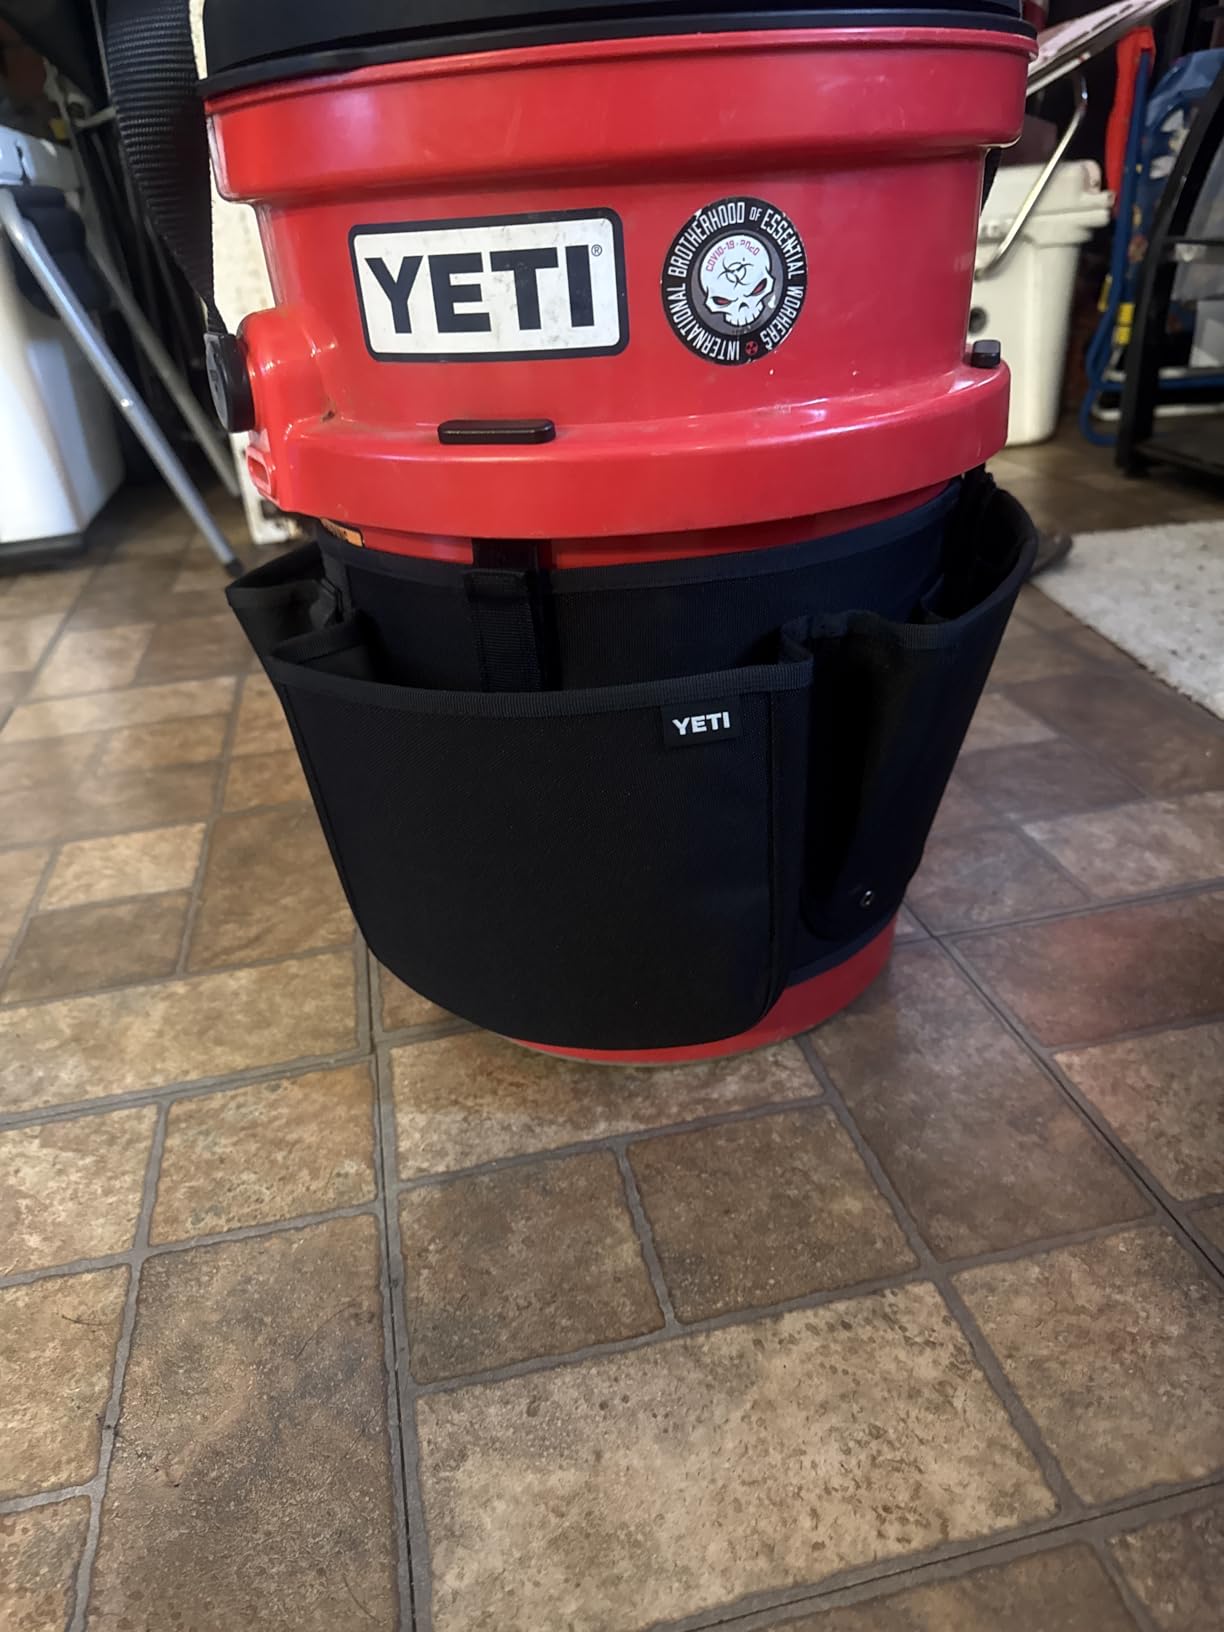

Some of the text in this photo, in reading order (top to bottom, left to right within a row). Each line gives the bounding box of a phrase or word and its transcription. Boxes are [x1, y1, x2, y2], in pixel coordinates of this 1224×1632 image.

[667, 202, 745, 278] BROTHERHOOD
[749, 206, 762, 221] OF
[760, 209, 805, 279] ESSENTIAL
[667, 283, 740, 361] INTERNATIONAL
[672, 711, 730, 735] YETI
